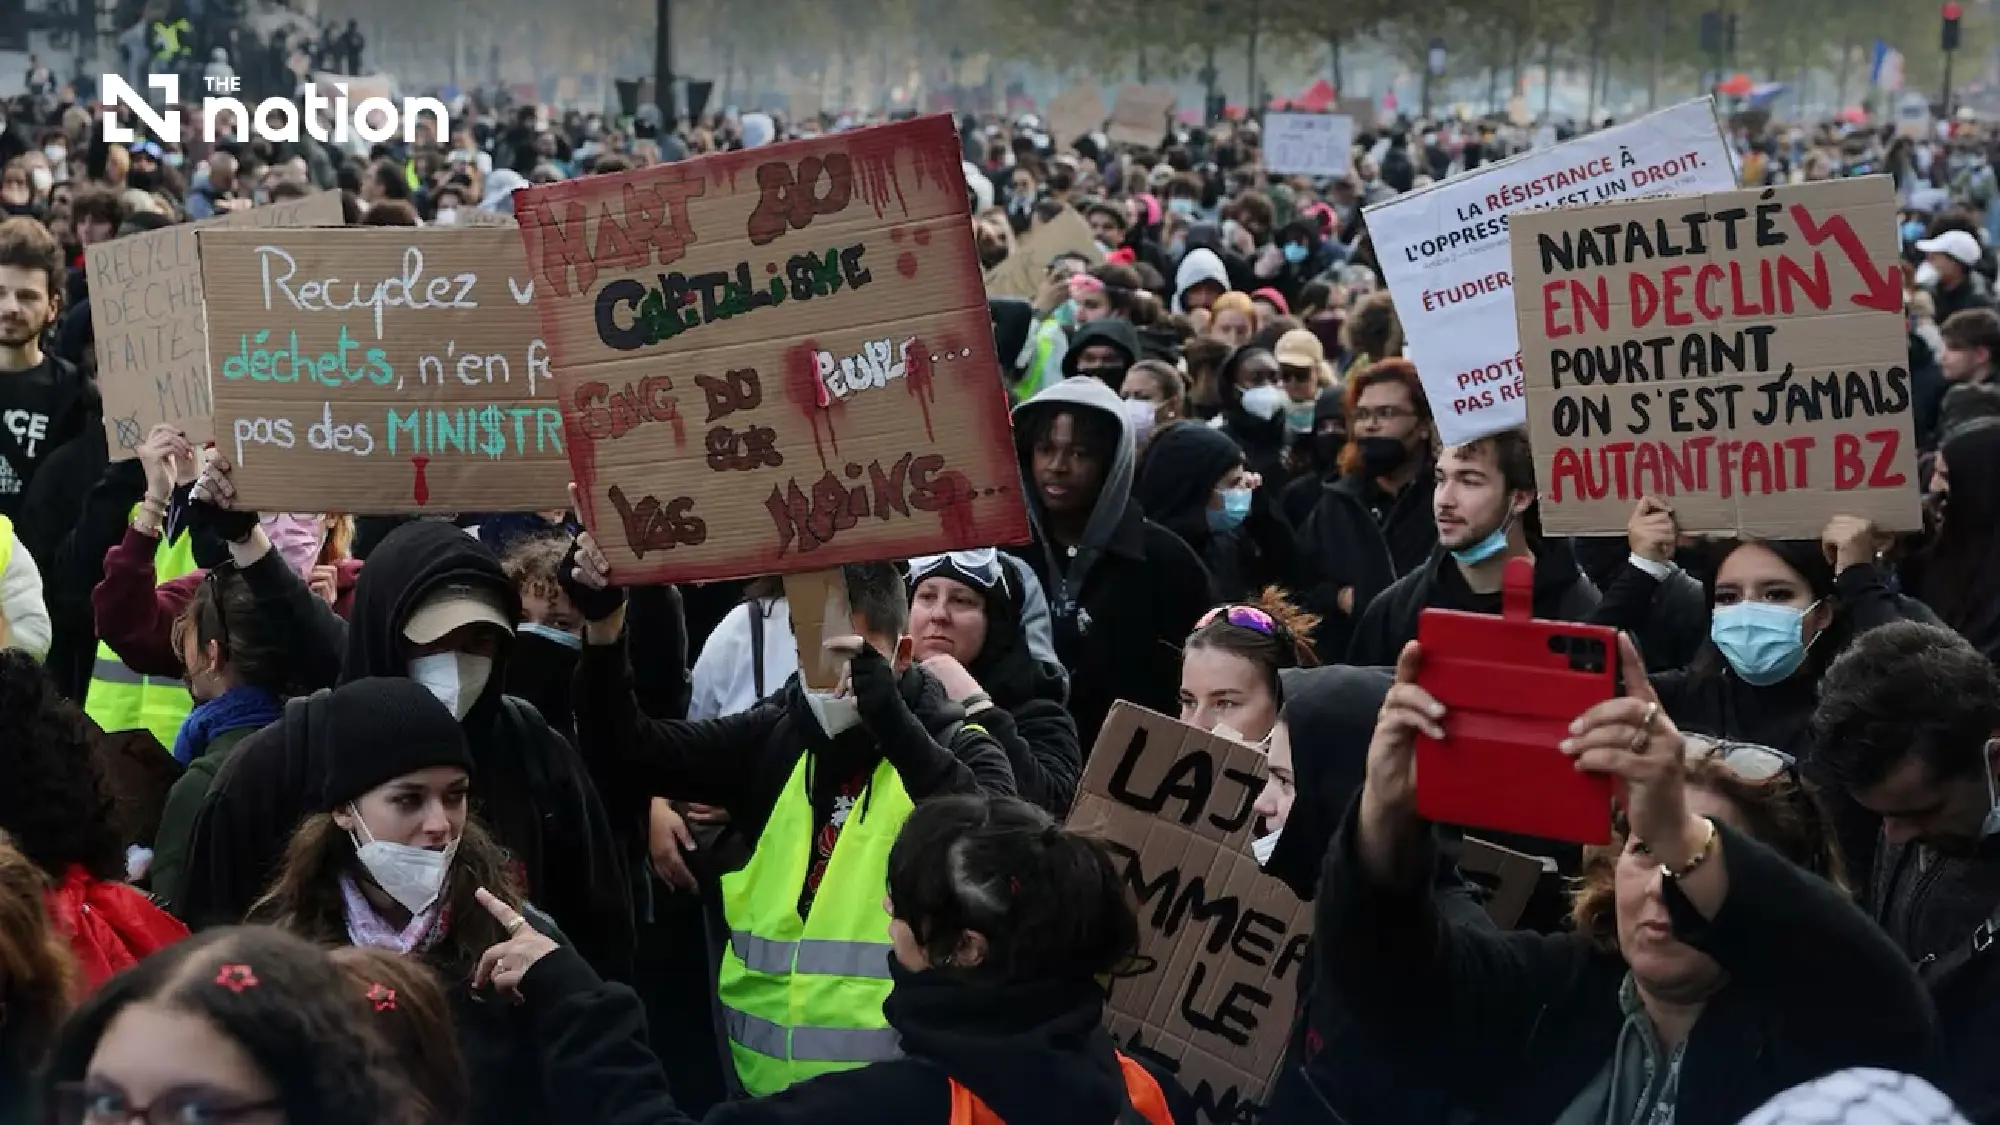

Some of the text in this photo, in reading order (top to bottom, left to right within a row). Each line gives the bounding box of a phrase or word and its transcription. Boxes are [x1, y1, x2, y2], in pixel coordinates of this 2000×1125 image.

[1457, 203, 1483, 221] LA
[1485, 156, 1615, 212] RÉSISTANCE
[1596, 179, 1627, 200] UN
[1631, 151, 1707, 188] DROIT.
[94, 229, 197, 287] RECYCL
[1537, 188, 1788, 274] NATALITÉ
[254, 246, 478, 340] Recyclez
[1543, 251, 1832, 338] EN DECLIN
[222, 325, 405, 392] déchets,
[419, 340, 510, 386] n'en
[3, 409, 49, 440] CE
[234, 417, 295, 468] pas
[307, 402, 374, 456] des
[1454, 390, 1494, 415] PAS
[1553, 393, 1611, 437] ON
[1628, 384, 1744, 435] S'EST
[1834, 429, 1906, 490] BZ
[1182, 962, 1271, 1046] LE
